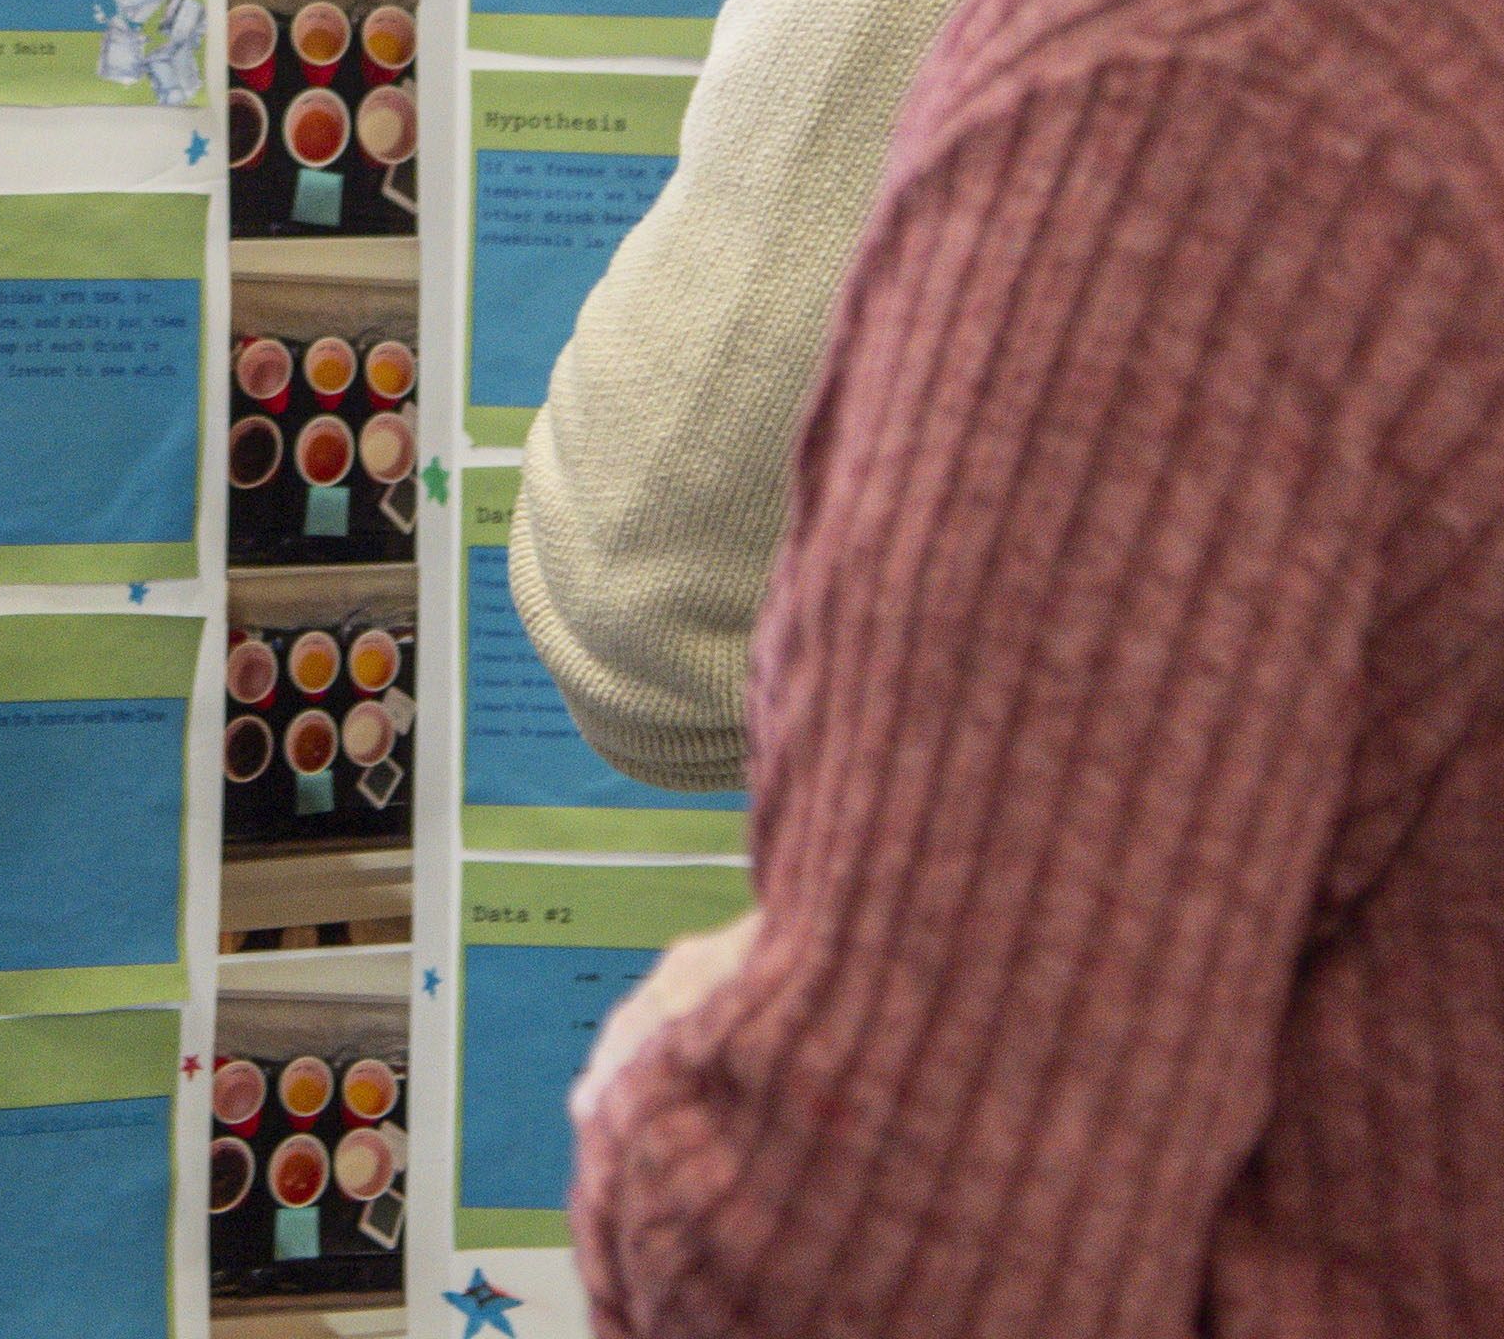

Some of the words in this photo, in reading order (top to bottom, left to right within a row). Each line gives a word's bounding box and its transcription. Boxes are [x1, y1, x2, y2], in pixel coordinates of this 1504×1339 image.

[485, 111, 628, 133] Hypothesis
[472, 905, 529, 925] Data
[543, 906, 572, 925] #2
